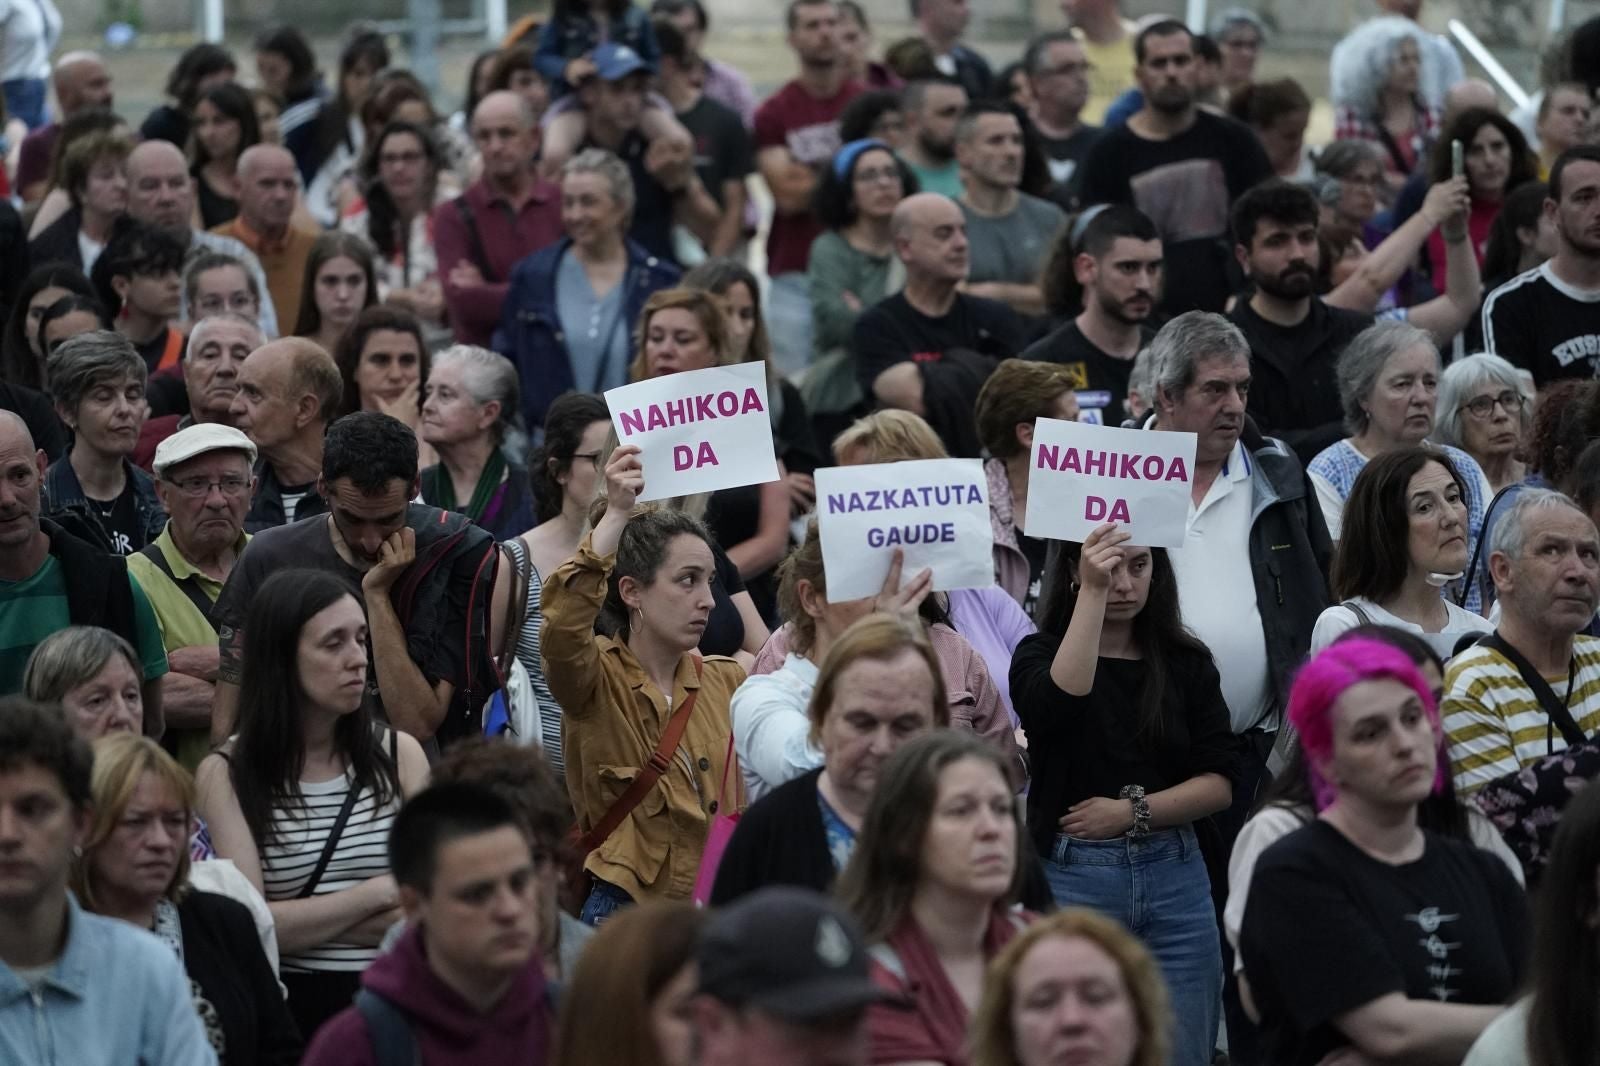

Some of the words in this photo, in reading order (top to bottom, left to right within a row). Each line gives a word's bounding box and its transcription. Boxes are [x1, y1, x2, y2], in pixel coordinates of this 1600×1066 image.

[619, 387, 764, 436] NAHIKOA
[673, 440, 720, 472] DA
[1037, 442, 1188, 482] NAHIKOA
[827, 483, 983, 514] NAZKATUTA
[1084, 496, 1131, 524] DA
[867, 522, 955, 549] GAUDE
